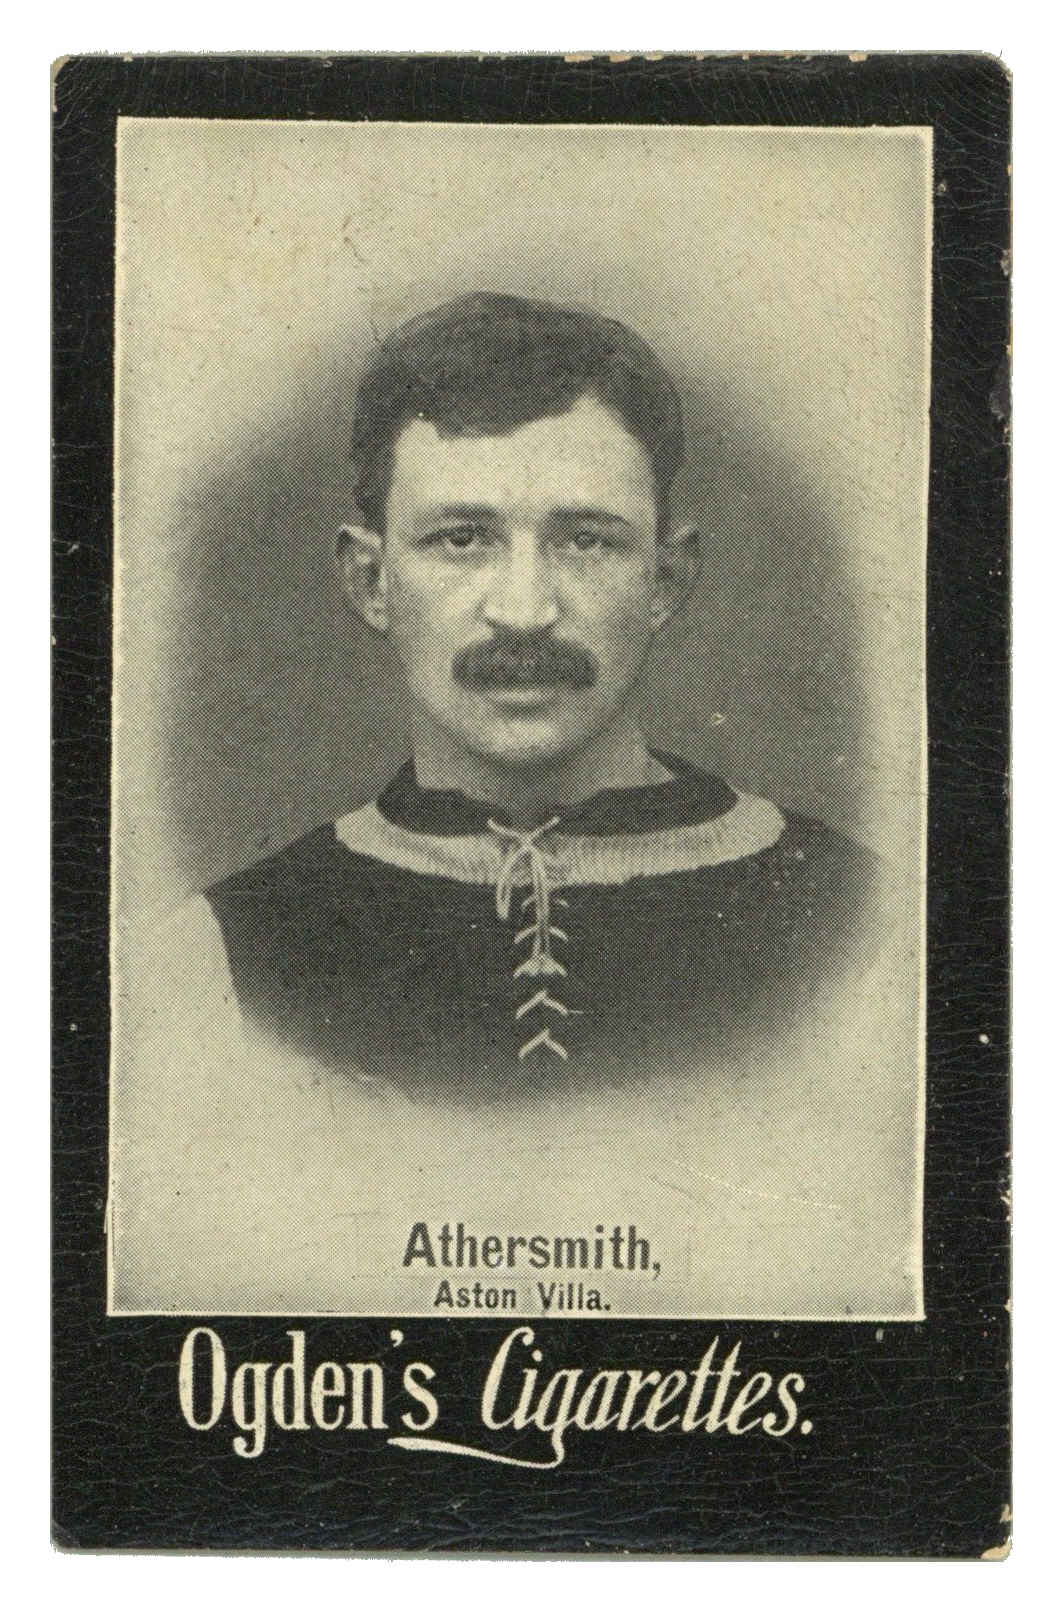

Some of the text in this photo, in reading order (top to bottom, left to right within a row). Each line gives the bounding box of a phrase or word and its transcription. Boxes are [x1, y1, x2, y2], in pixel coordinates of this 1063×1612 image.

[403, 1222, 661, 1280] Athersmith,
[433, 1280, 611, 1312] Aston Villa.
[178, 1326, 813, 1469] Ogden's Cigarettes.
